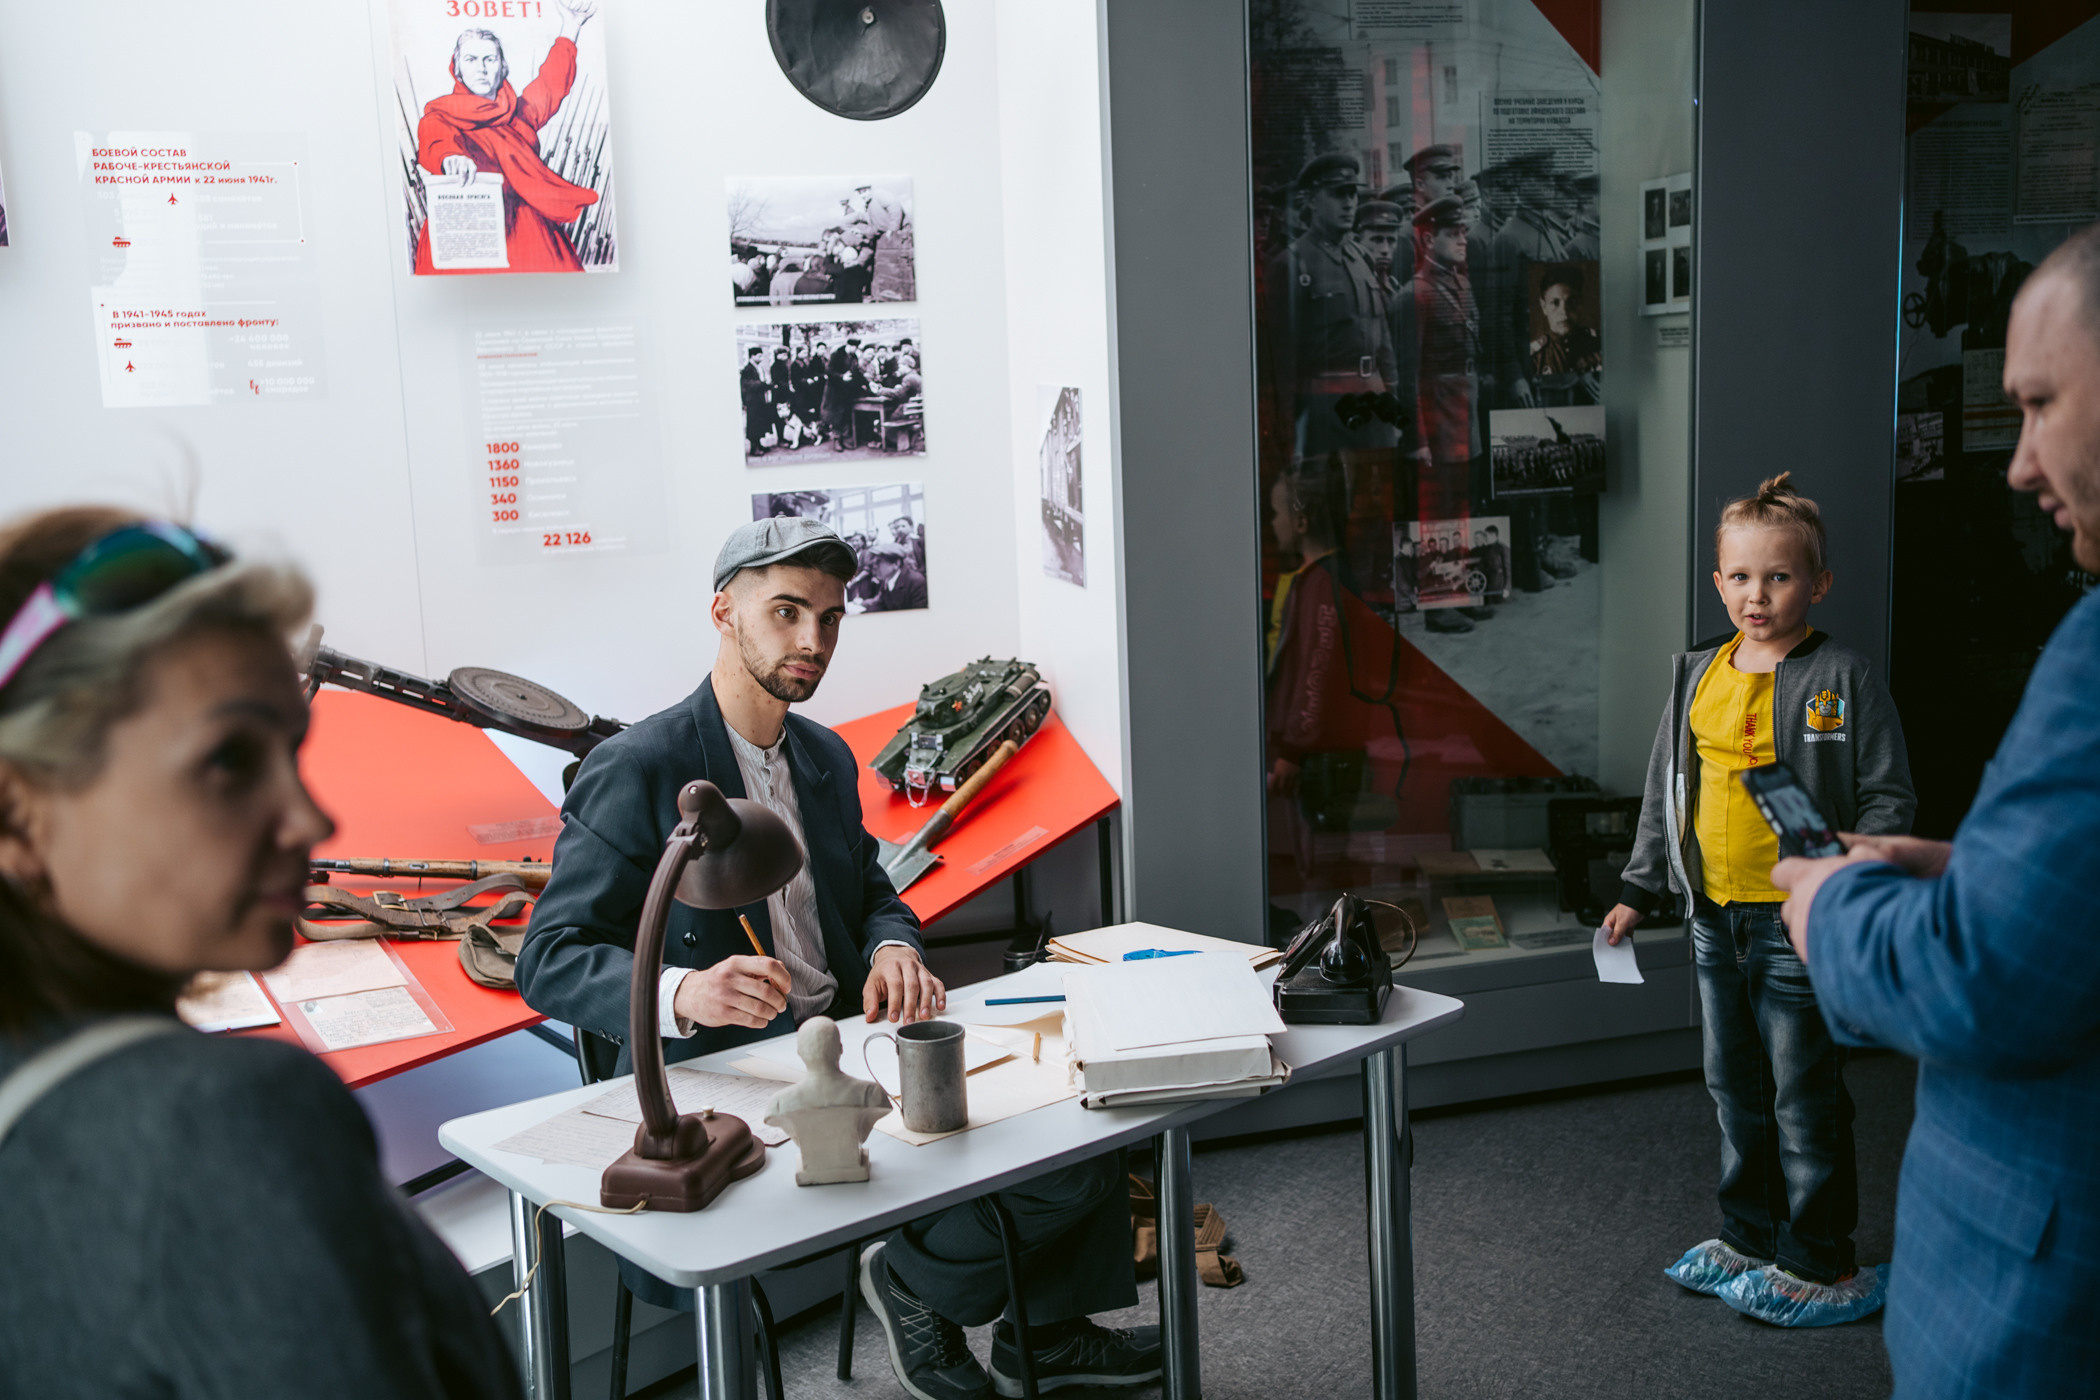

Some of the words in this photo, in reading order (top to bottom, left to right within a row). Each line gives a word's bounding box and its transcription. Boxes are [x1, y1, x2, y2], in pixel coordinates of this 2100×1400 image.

[446, 0, 542, 18] ЗОВЕТ!
[92, 147, 138, 157] БОЕВОЙ
[140, 148, 187, 157] СОСТАВ
[93, 160, 231, 171] РАБОЧЕ-КРЕСТЬЯНСКОЙ
[95, 174, 150, 184] КРАСНОЙ
[152, 175, 191, 184] АРМИИ
[203, 175, 216, 184] 22
[112, 311, 120, 319] В
[175, 311, 207, 319] годах
[110, 321, 162, 330] призвано
[173, 318, 236, 327] поставлено
[237, 317, 279, 328] фронту:
[485, 441, 520, 455] 1800
[487, 458, 520, 471] 1360
[489, 475, 519, 488] 1150
[490, 491, 517, 505] 340
[492, 508, 519, 522] 300
[543, 533, 562, 547] 22
[565, 531, 592, 545] 126
[1745, 713, 1757, 738] THANK
[1803, 732, 1846, 743] TRANSFORMERS
[1742, 738, 1754, 755] YOU
